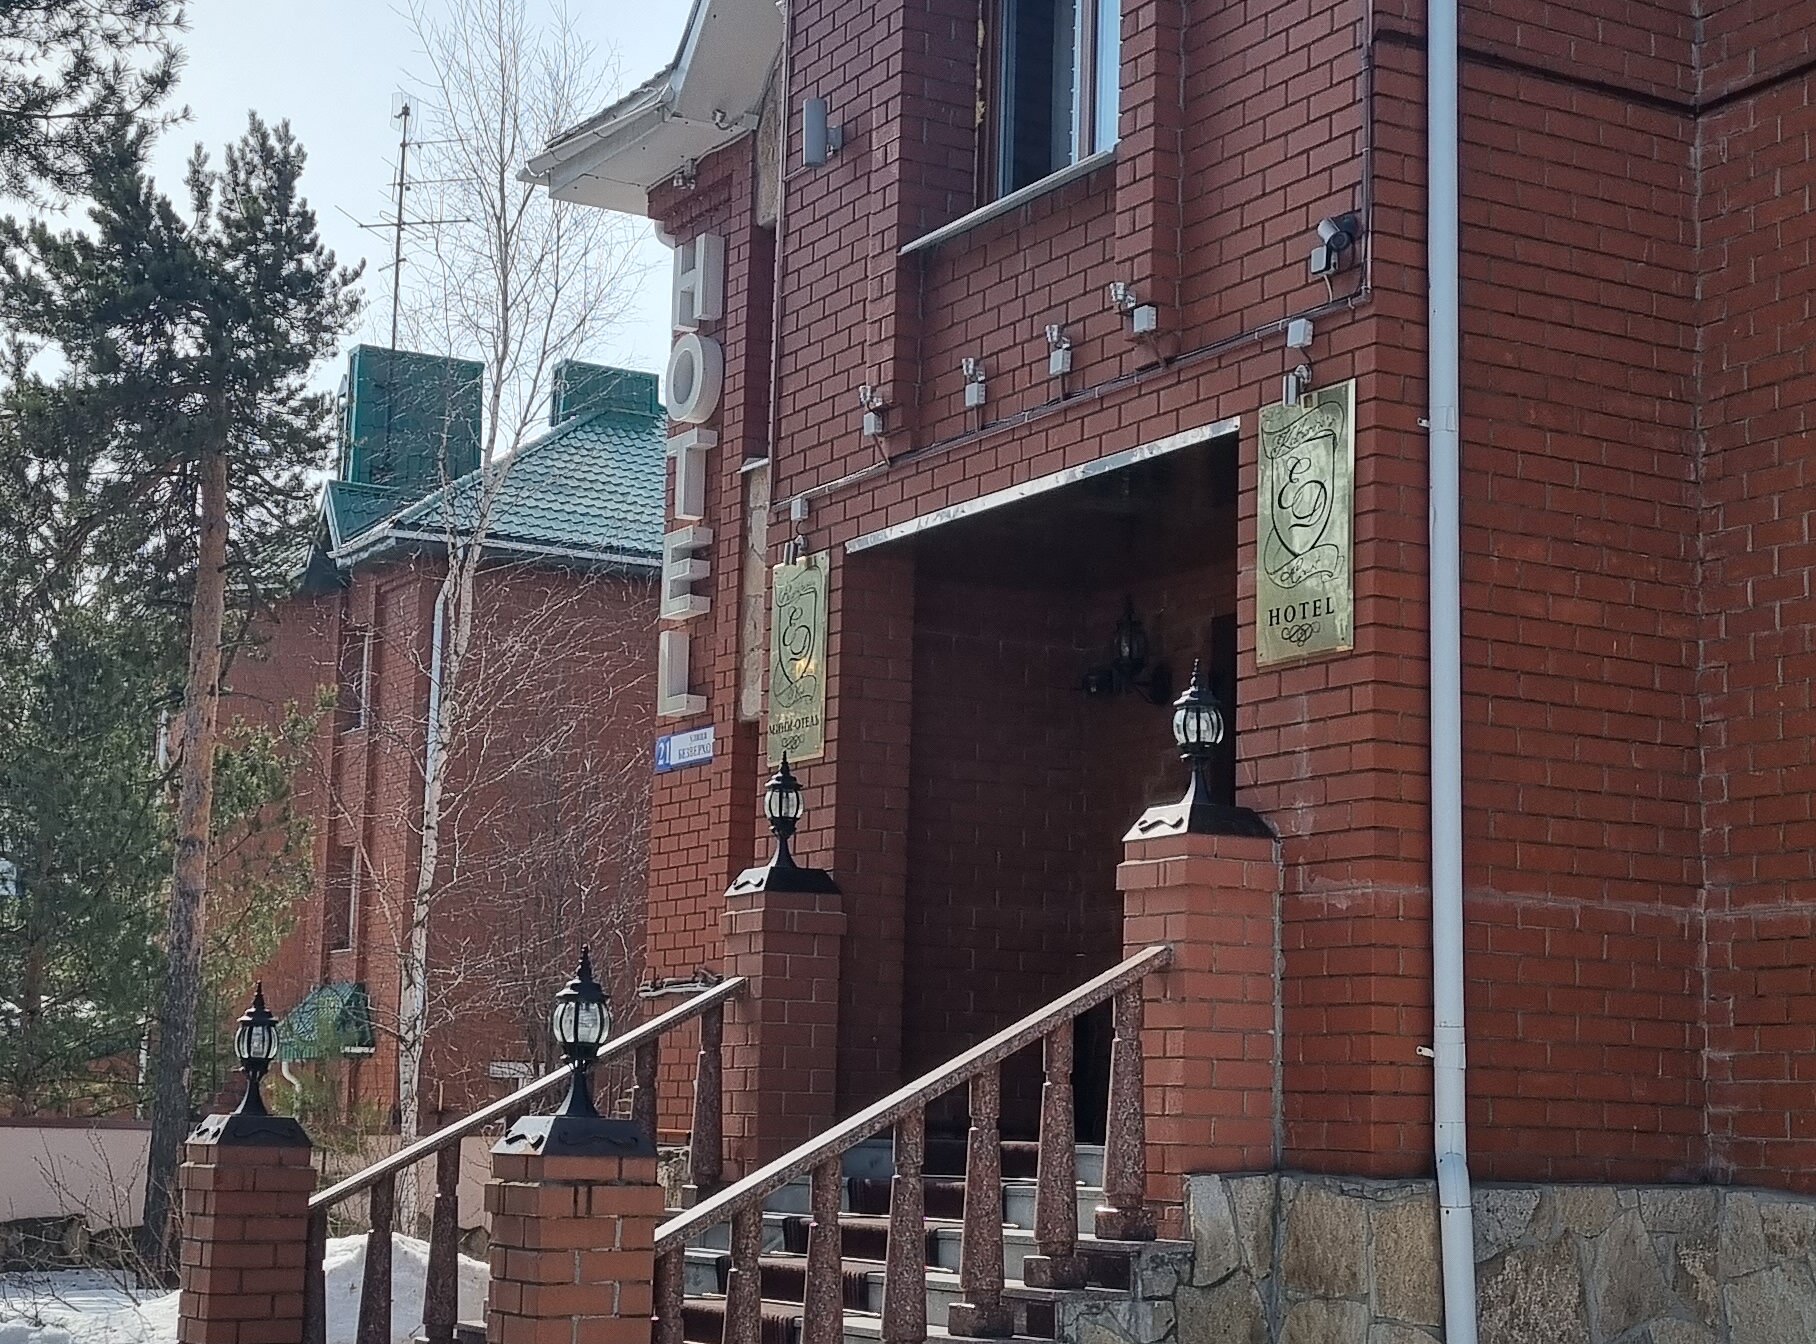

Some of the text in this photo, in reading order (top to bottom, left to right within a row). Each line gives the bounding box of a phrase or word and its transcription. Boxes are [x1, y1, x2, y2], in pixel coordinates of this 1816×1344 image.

[657, 232, 725, 718] HOTEL
[1268, 596, 1335, 627] HOTEL
[769, 714, 820, 735] МИНИ-ОТЕЛЬ
[657, 740, 670, 766] 21
